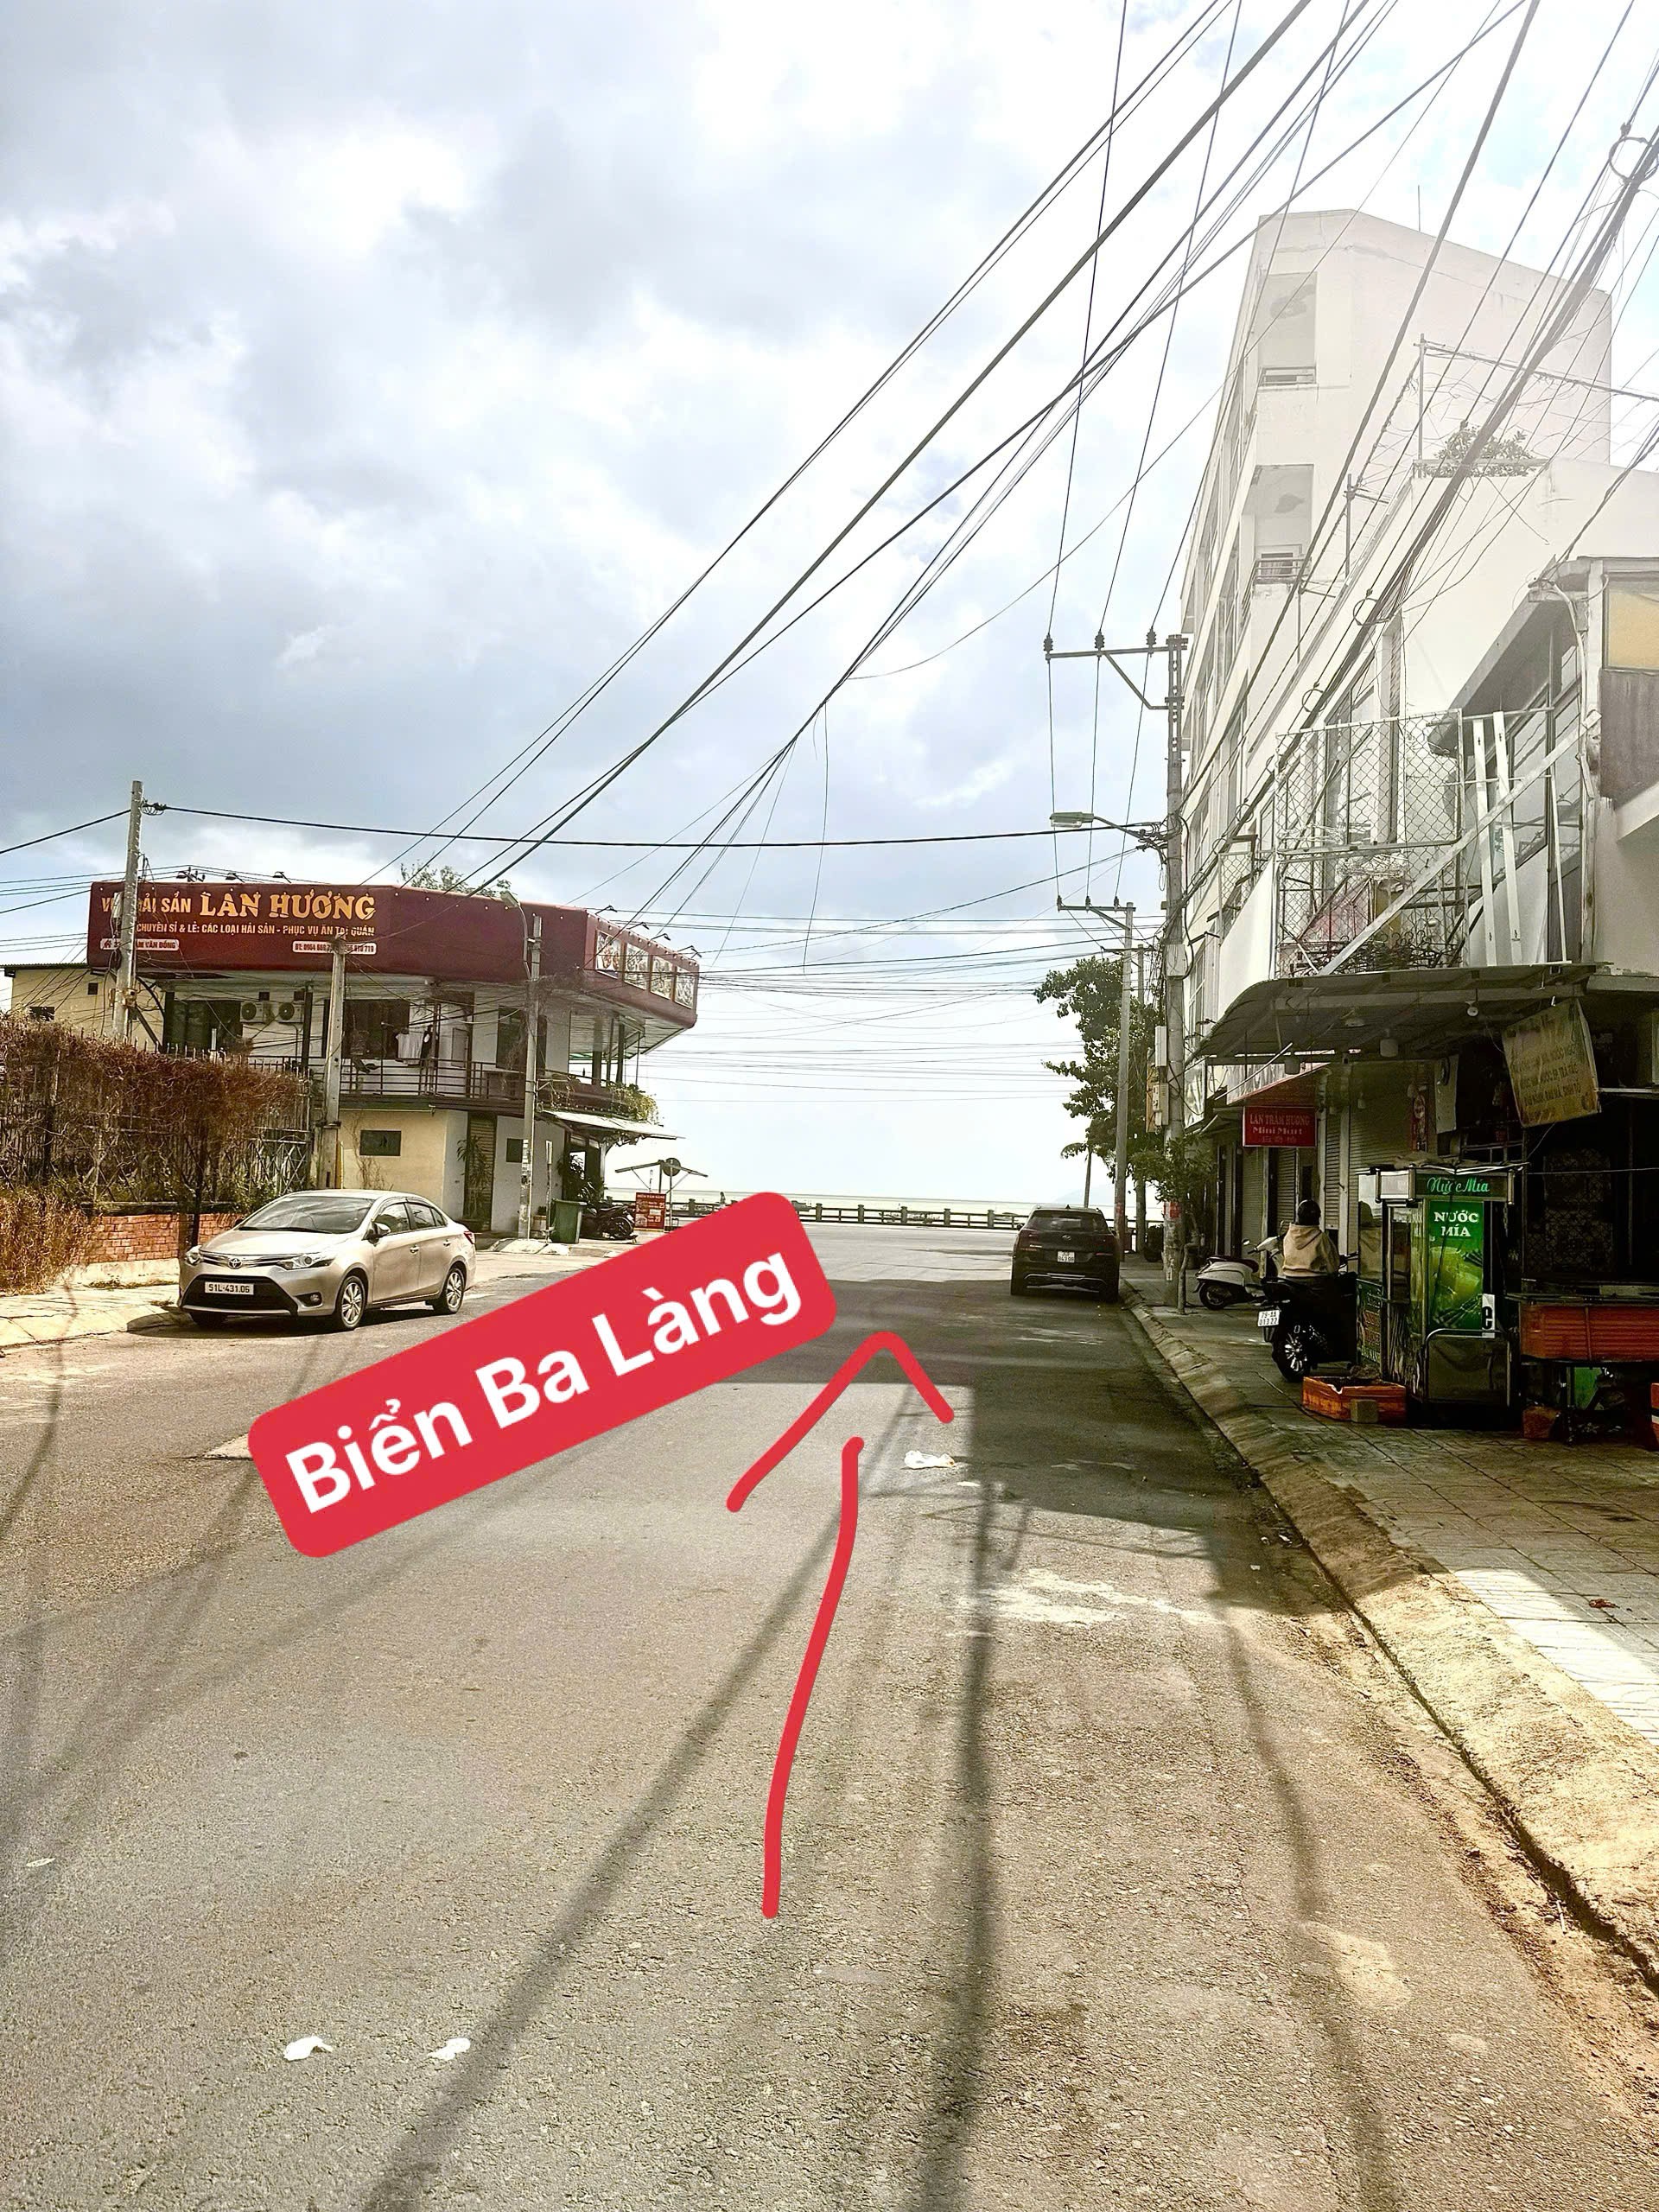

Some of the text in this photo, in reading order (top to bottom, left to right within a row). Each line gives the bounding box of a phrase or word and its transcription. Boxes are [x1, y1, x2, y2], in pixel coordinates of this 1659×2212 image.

[200, 893, 261, 918] LAN
[269, 889, 376, 920] HƯƠNG
[179, 924, 186, 933] &
[201, 923, 218, 933] CÁC
[220, 924, 239, 936] LOẠI
[241, 922, 256, 934] HẢI
[258, 922, 275, 934] SẢN
[283, 925, 305, 937] PHỤC
[308, 925, 319, 937] VỤ
[1277, 1127, 1303, 1135] Mart
[1433, 1210, 1479, 1223] NƯỚC
[1441, 1224, 1471, 1236] MÍA
